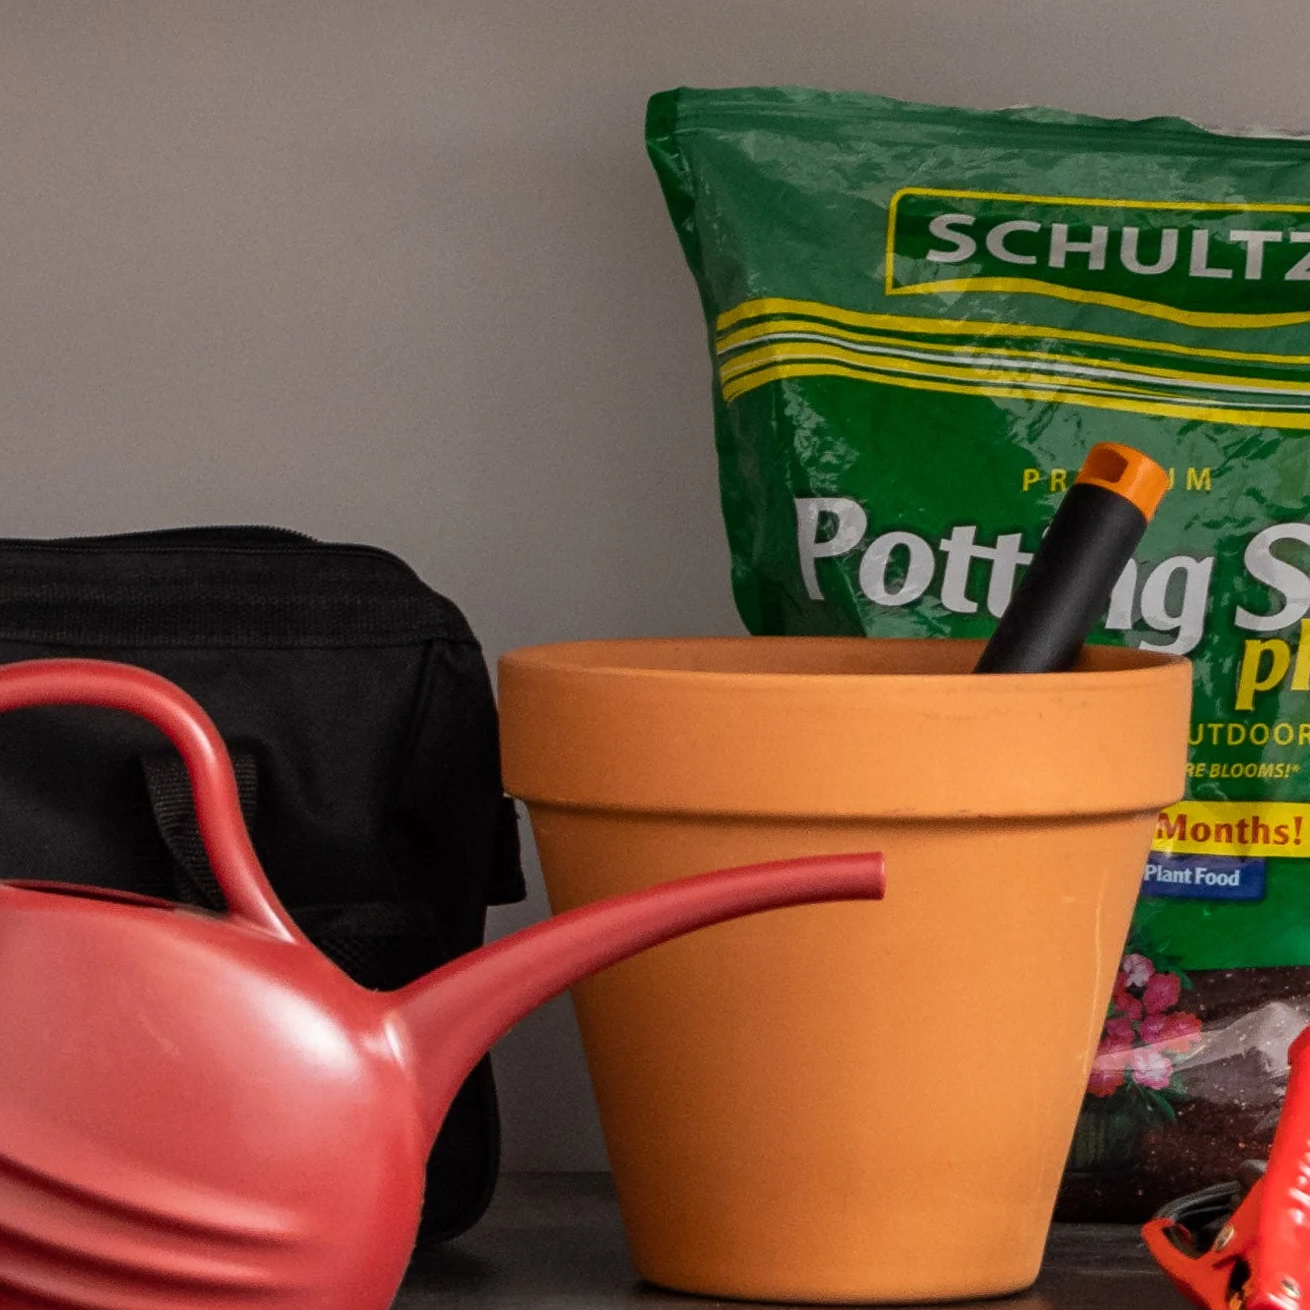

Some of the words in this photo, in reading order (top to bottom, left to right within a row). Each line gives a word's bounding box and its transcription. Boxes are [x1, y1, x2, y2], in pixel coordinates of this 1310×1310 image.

[794, 496, 1216, 656] Pottng
[1157, 812, 1304, 846] Months!
[1144, 864, 1193, 884] Plant
[1195, 867, 1240, 887] Food
